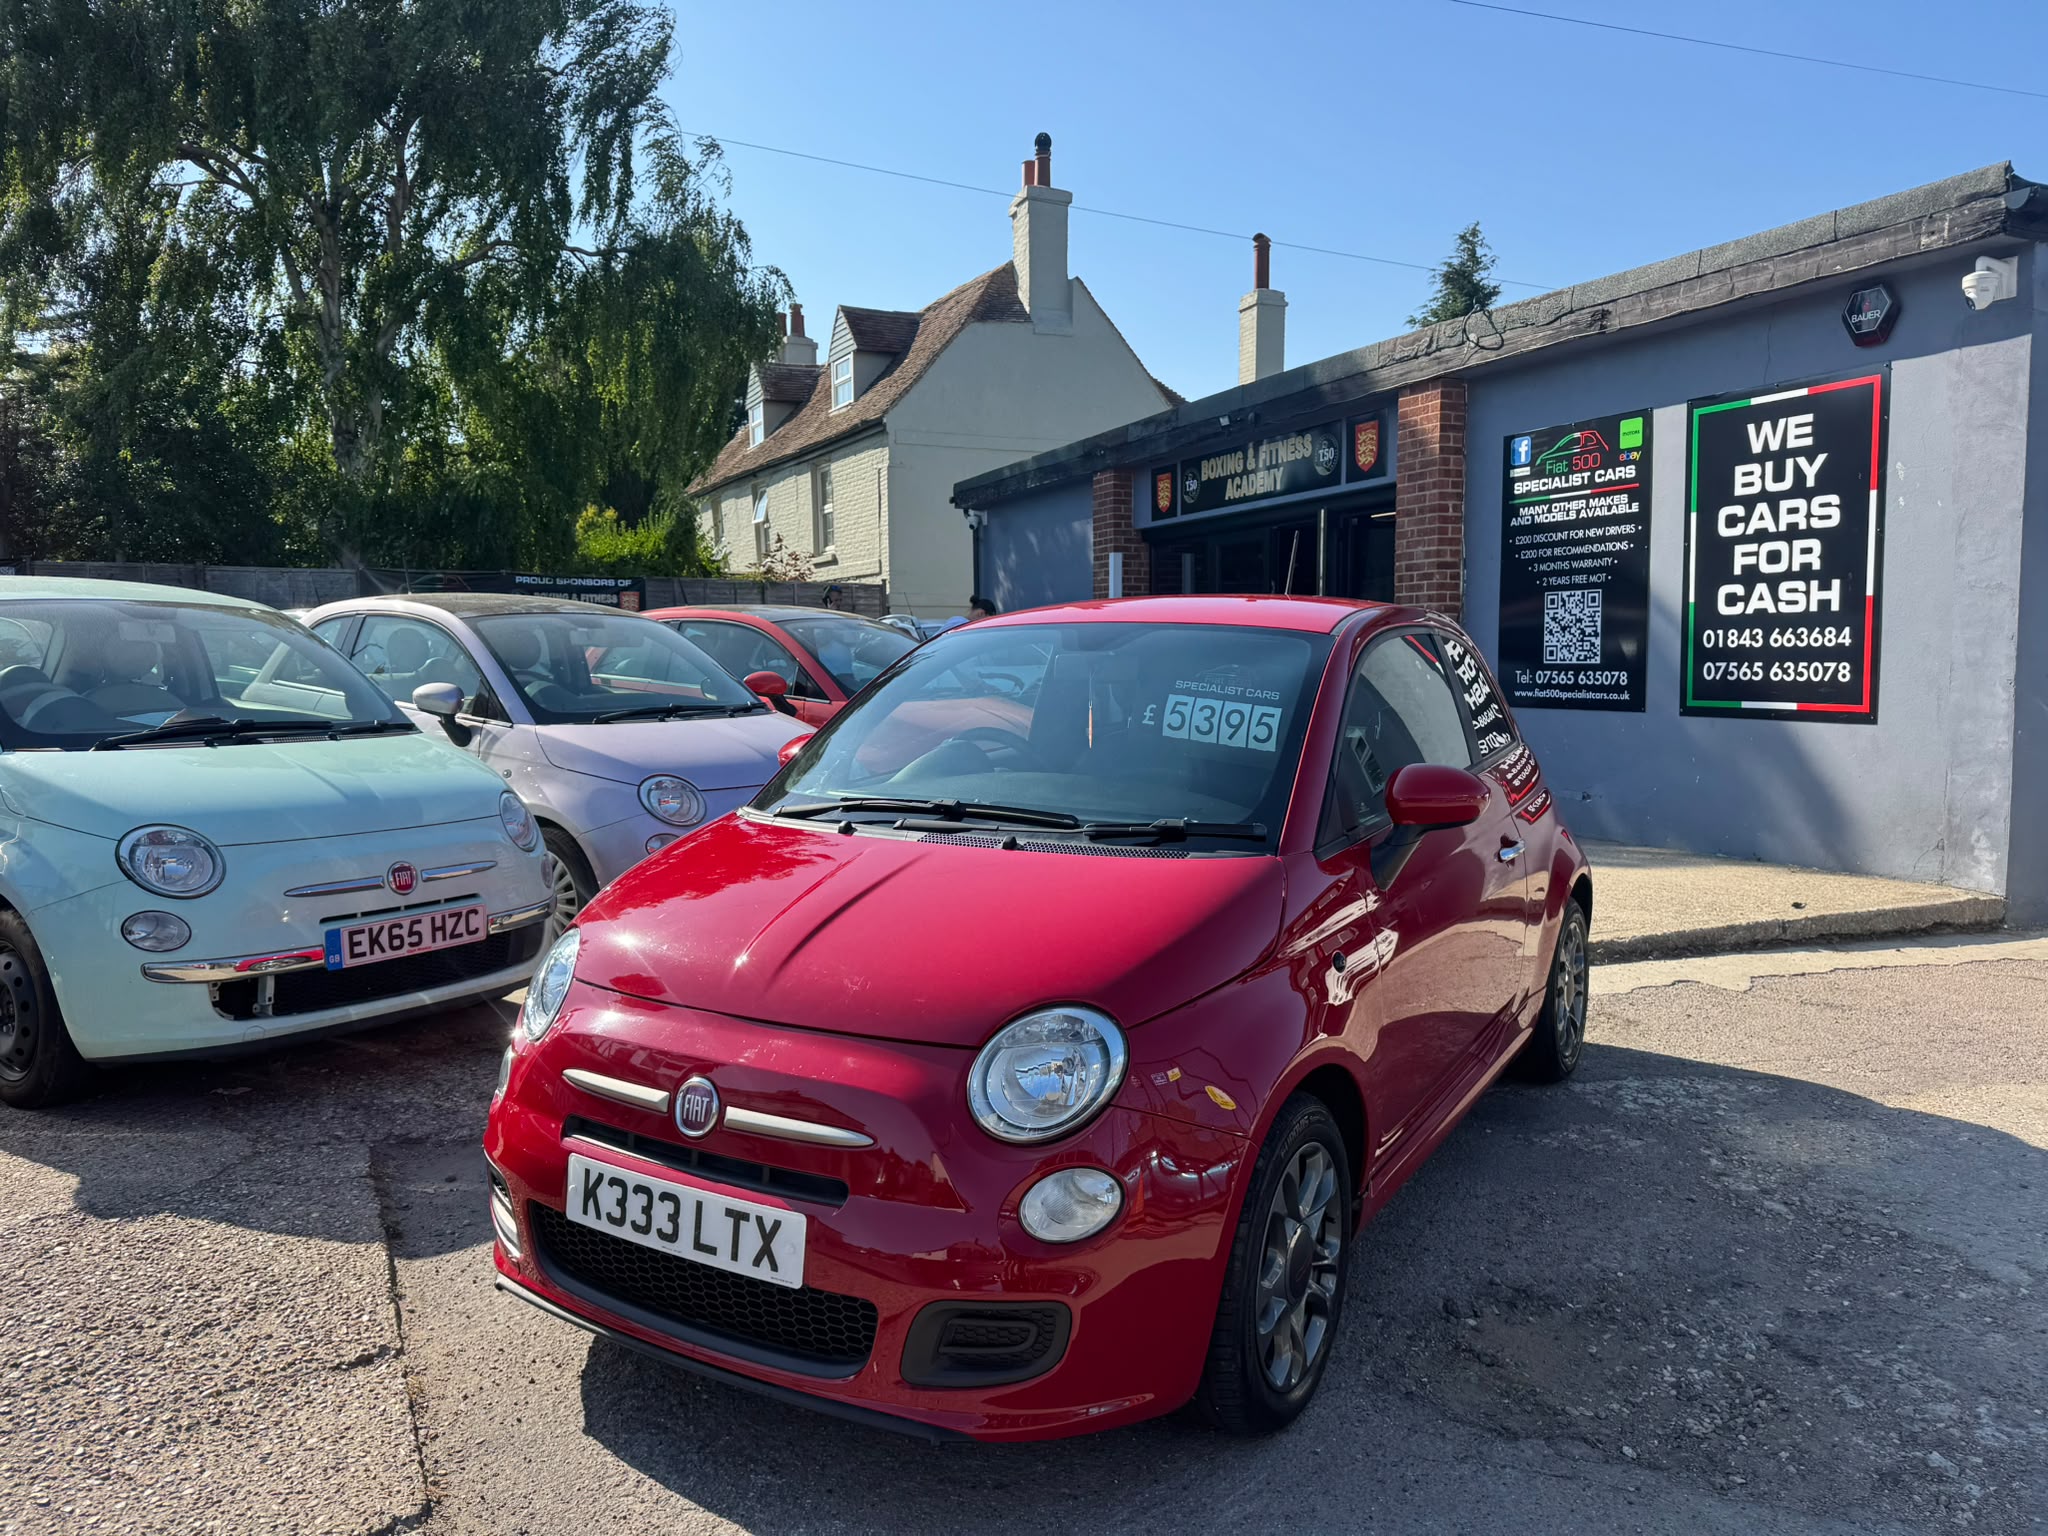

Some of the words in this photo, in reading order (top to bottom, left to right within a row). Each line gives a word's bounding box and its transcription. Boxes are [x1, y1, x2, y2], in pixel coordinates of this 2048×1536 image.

[1851, 309, 1881, 323] BAUER
[1747, 413, 1814, 454] WE
[1200, 451, 1244, 482] BOXING
[1246, 443, 1256, 471] &
[1258, 433, 1313, 468] FITNESS
[1546, 460, 1569, 475] Fiat
[1572, 452, 1601, 471] 500
[1619, 450, 1641, 462] ebay
[1225, 466, 1284, 500] ACADEMY
[1514, 472, 1591, 495] SPECIALIST
[1594, 465, 1636, 483] CARS
[1734, 452, 1829, 497] BUY
[1510, 516, 1532, 527] AND
[1534, 510, 1577, 524] MODELS
[1579, 502, 1640, 519] AVAILABLE
[1519, 504, 1549, 516] MANY
[1551, 498, 1586, 511] OTHER
[1589, 494, 1628, 507] MAKES
[1717, 494, 1841, 538] CARS
[1515, 535, 1532, 545] £200
[1533, 531, 1568, 543] DISCOUNT
[1569, 530, 1584, 539] FOR
[1585, 528, 1605, 538] NEW
[1605, 524, 1636, 536] DRIVERS
[1520, 549, 1537, 559] £200
[1538, 548, 1552, 557] FOR
[1553, 541, 1629, 557] RECOMMENDATIONS
[1733, 538, 1822, 576] FOR
[1533, 563, 1538, 572] 3
[1539, 560, 1570, 571] MONTHS
[1570, 557, 1613, 569] WARRANTY
[515, 575, 554, 585] PROUD
[556, 577, 615, 587] SPONSORS
[617, 579, 632, 587] OF
[1542, 578, 1548, 586] 2
[1548, 575, 1570, 586] YEARS
[1571, 574, 1588, 584] FREE
[1589, 573, 1607, 583] MOT
[1717, 579, 1841, 616] CASH
[1702, 628, 1764, 648] 01843
[1769, 626, 1852, 648] 663684
[1515, 669, 1532, 684] Tel:
[1535, 670, 1574, 685] 07565
[1578, 671, 1628, 686] 635078
[1702, 661, 1764, 681] 07565
[1769, 661, 1851, 682] 635078
[1175, 680, 1244, 696] SPECIALIST
[1245, 688, 1280, 700] CARS
[1514, 688, 1631, 701] www.fiat500specialistcars.co.uk
[1142, 704, 1157, 725] £
[1166, 701, 1276, 744] 5395
[395, 870, 411, 887] FIAT
[348, 919, 423, 960] EK65
[431, 908, 480, 944] HZC
[329, 954, 340, 964] GB
[682, 1094, 710, 1123] FIAT
[582, 1168, 681, 1244] K333
[692, 1200, 782, 1273] LTX
